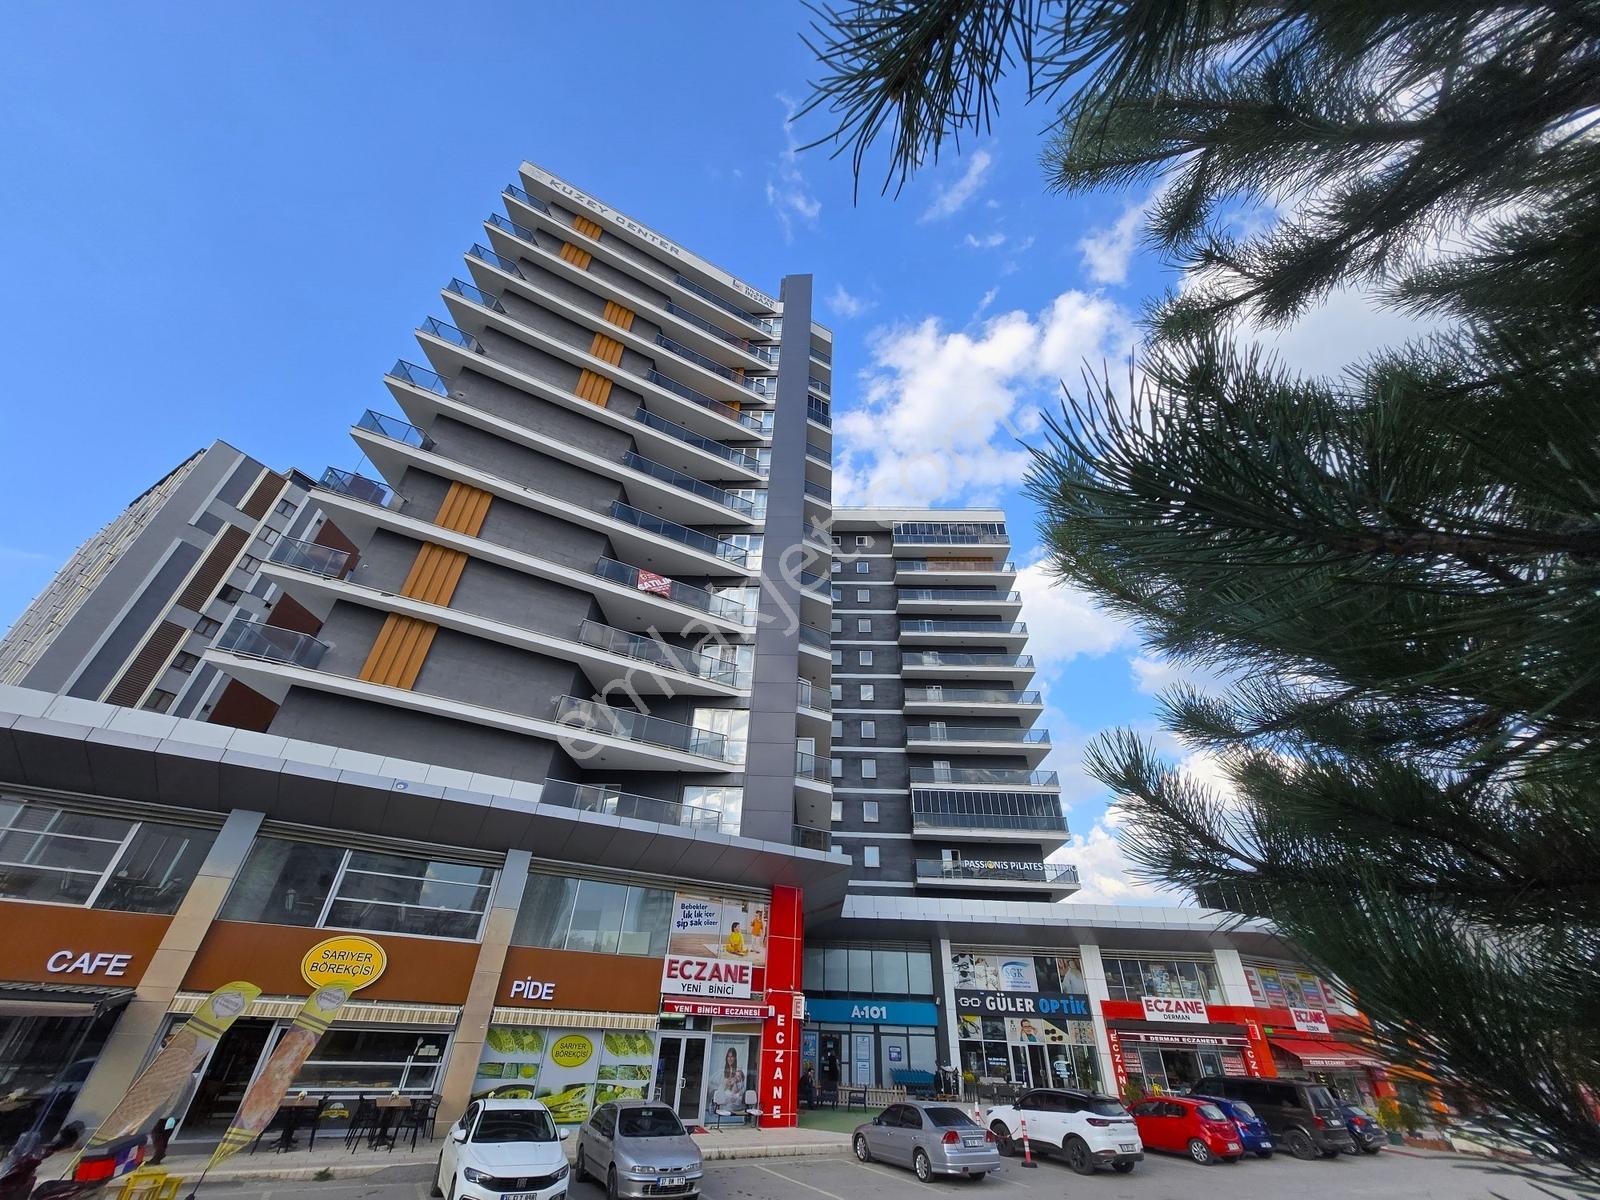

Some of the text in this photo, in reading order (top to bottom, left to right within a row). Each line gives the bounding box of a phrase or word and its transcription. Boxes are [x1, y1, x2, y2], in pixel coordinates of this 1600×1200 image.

[550, 179, 680, 255] KUZEY CENTER
[46, 950, 133, 977] CAFE
[321, 949, 373, 963] SARIYER
[666, 959, 749, 984] ECZANE
[986, 993, 1088, 1015] GÜLER OPTİK
[1145, 999, 1205, 1014] ECZANE
[1163, 1013, 1191, 1021] DERMAN
[1294, 1009, 1326, 1025] ECZANE
[773, 1014, 786, 1119] ECZANE
